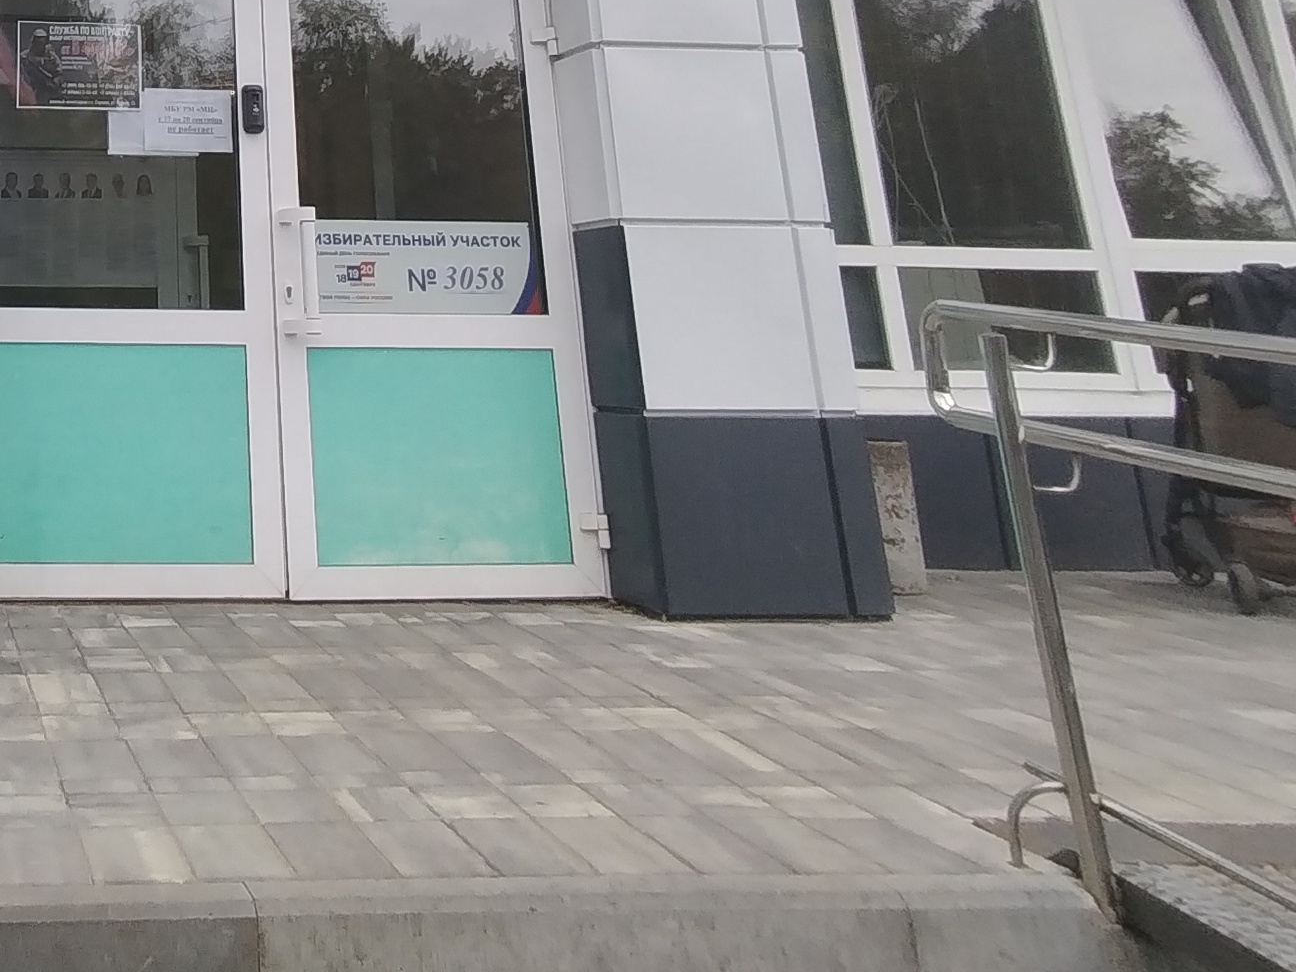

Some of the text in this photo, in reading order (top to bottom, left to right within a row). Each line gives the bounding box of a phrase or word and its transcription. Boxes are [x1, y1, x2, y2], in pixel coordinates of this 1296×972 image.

[49, 26, 79, 36] СЛУЖБА
[178, 125, 215, 134] работает
[315, 232, 521, 247] ИЗБИРАТЕЛЬНЫЙ УЧАСТОК
[336, 264, 373, 283] 18 19 20
[407, 266, 504, 292] № 3058
